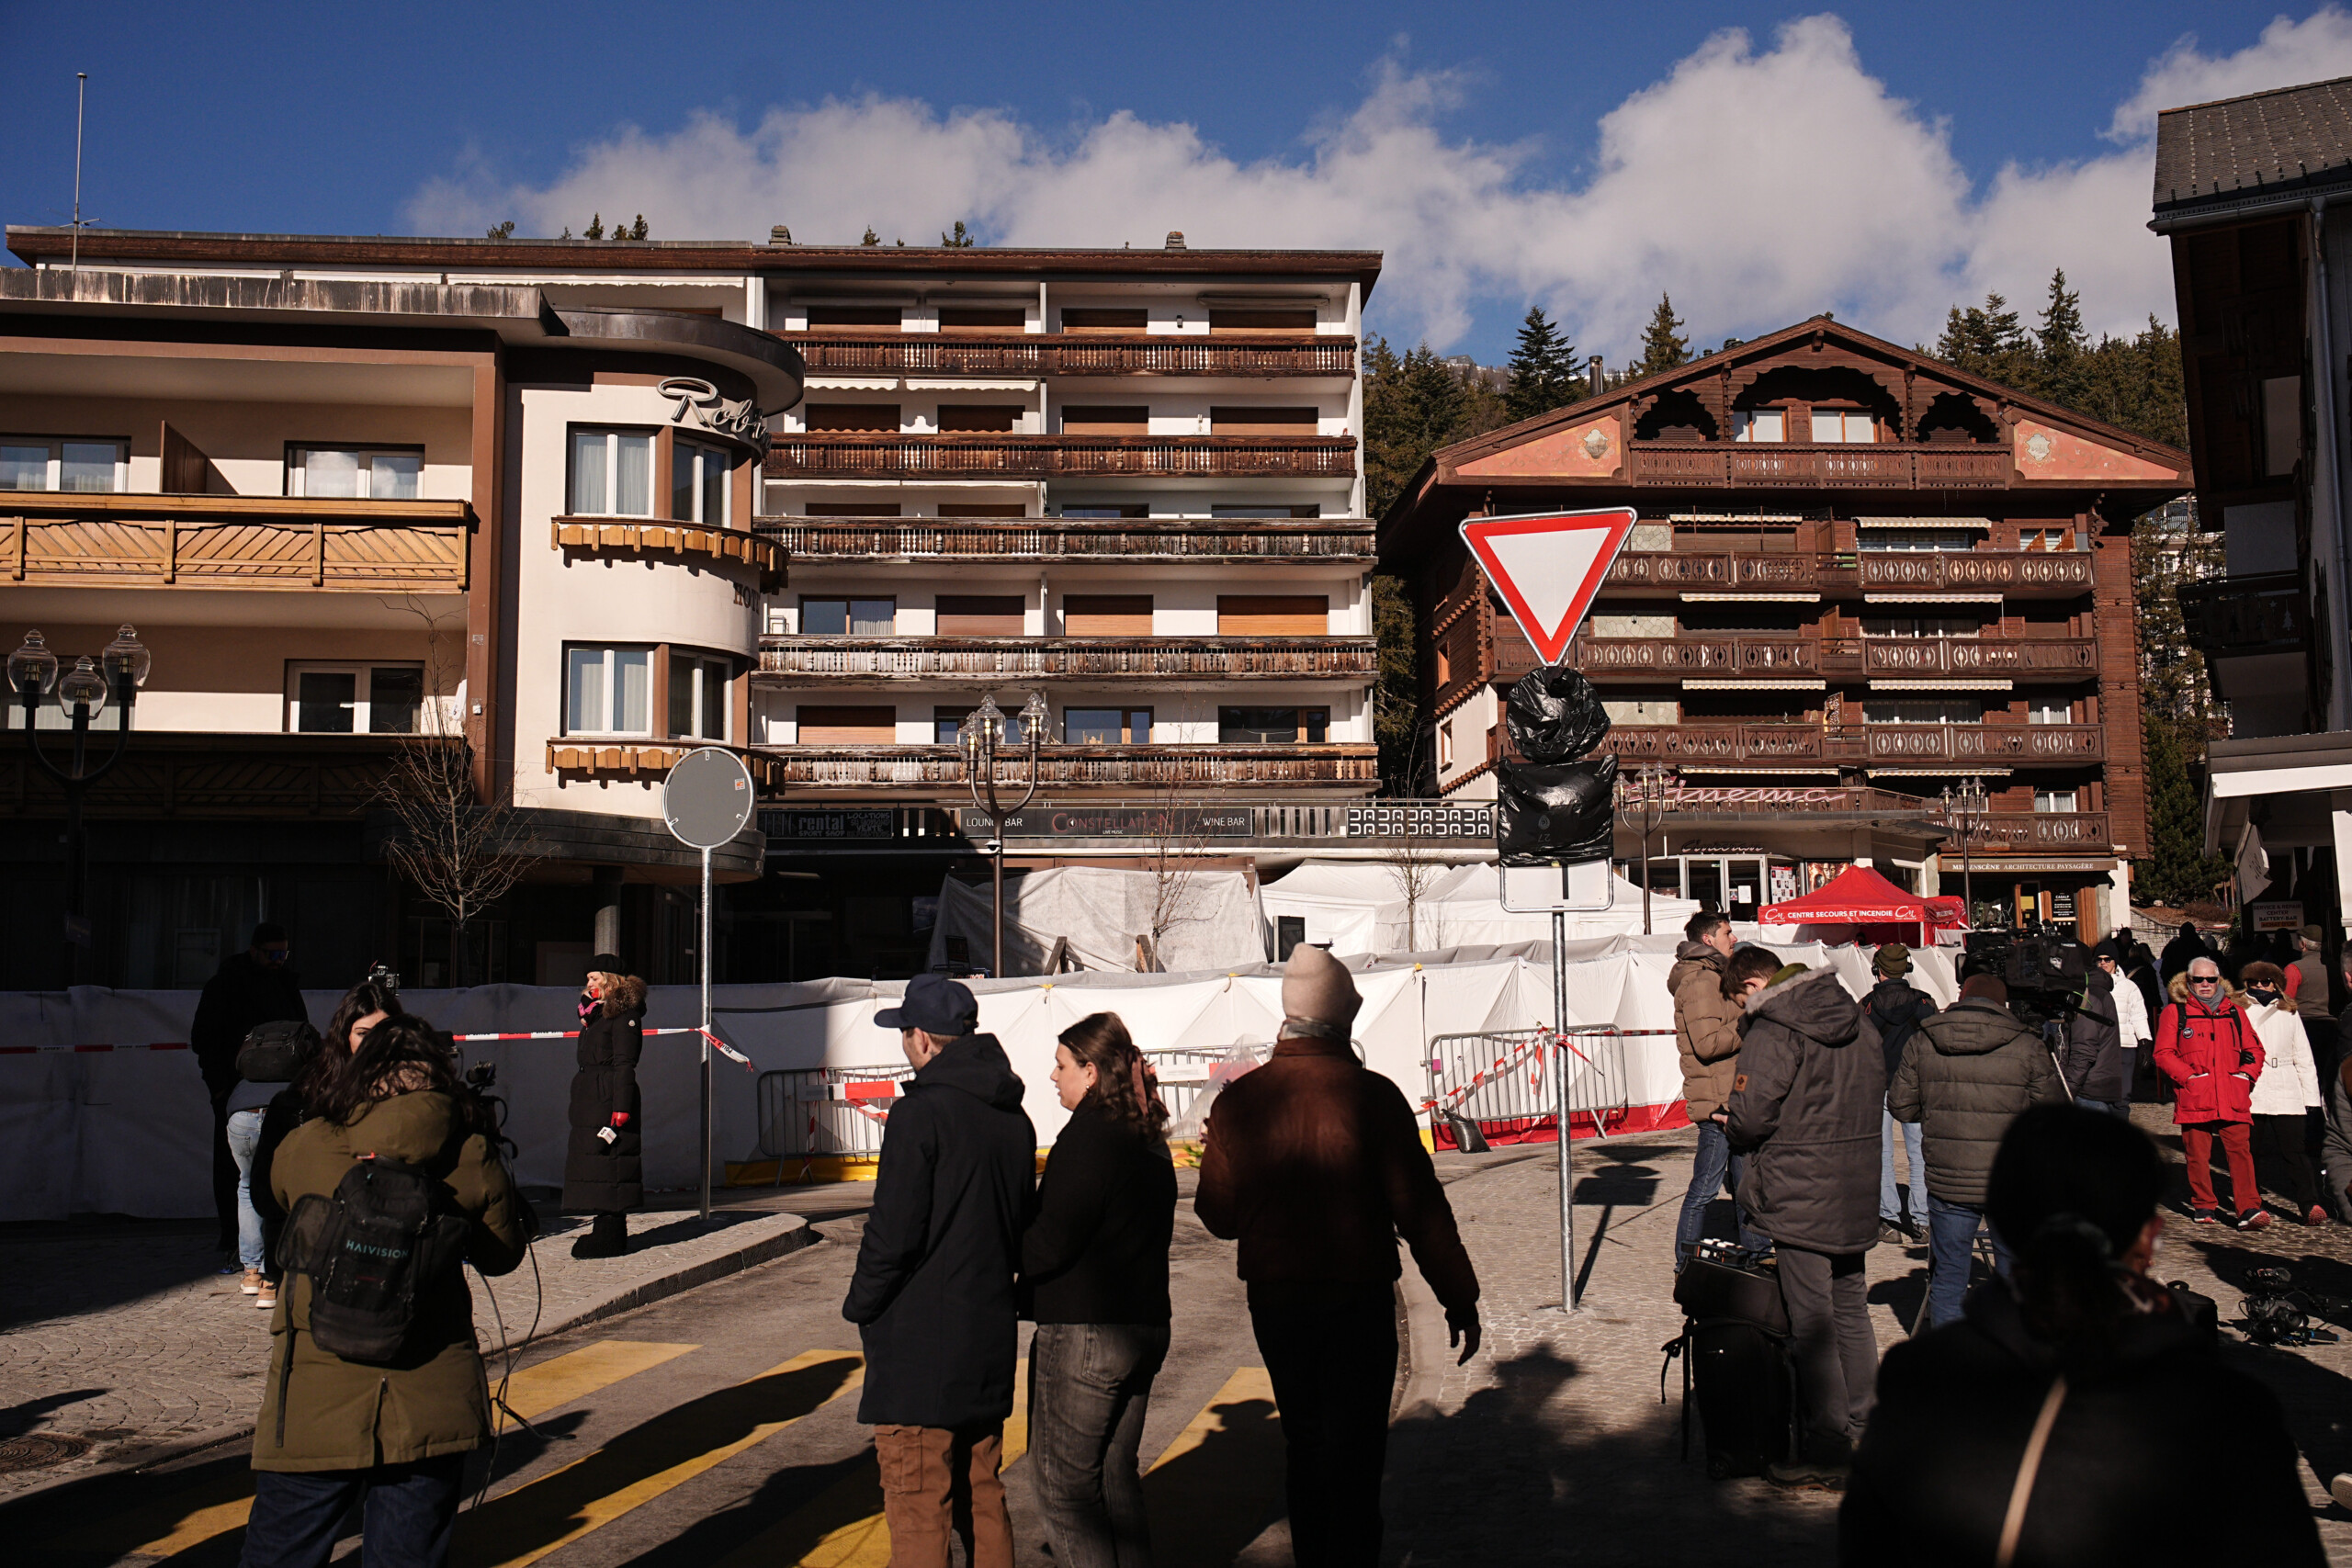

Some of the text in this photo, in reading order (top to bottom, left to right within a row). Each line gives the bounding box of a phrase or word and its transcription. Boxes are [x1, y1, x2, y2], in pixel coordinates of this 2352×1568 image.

[798, 814, 844, 830] rental
[1004, 818, 1023, 828] BAR
[1202, 817, 1245, 827] WINE BAR
[2003, 863, 2055, 871] ARCHITECTURE
[2056, 862, 2094, 870] PAYSAGÈRE
[345, 1239, 410, 1259] HAIVISION
